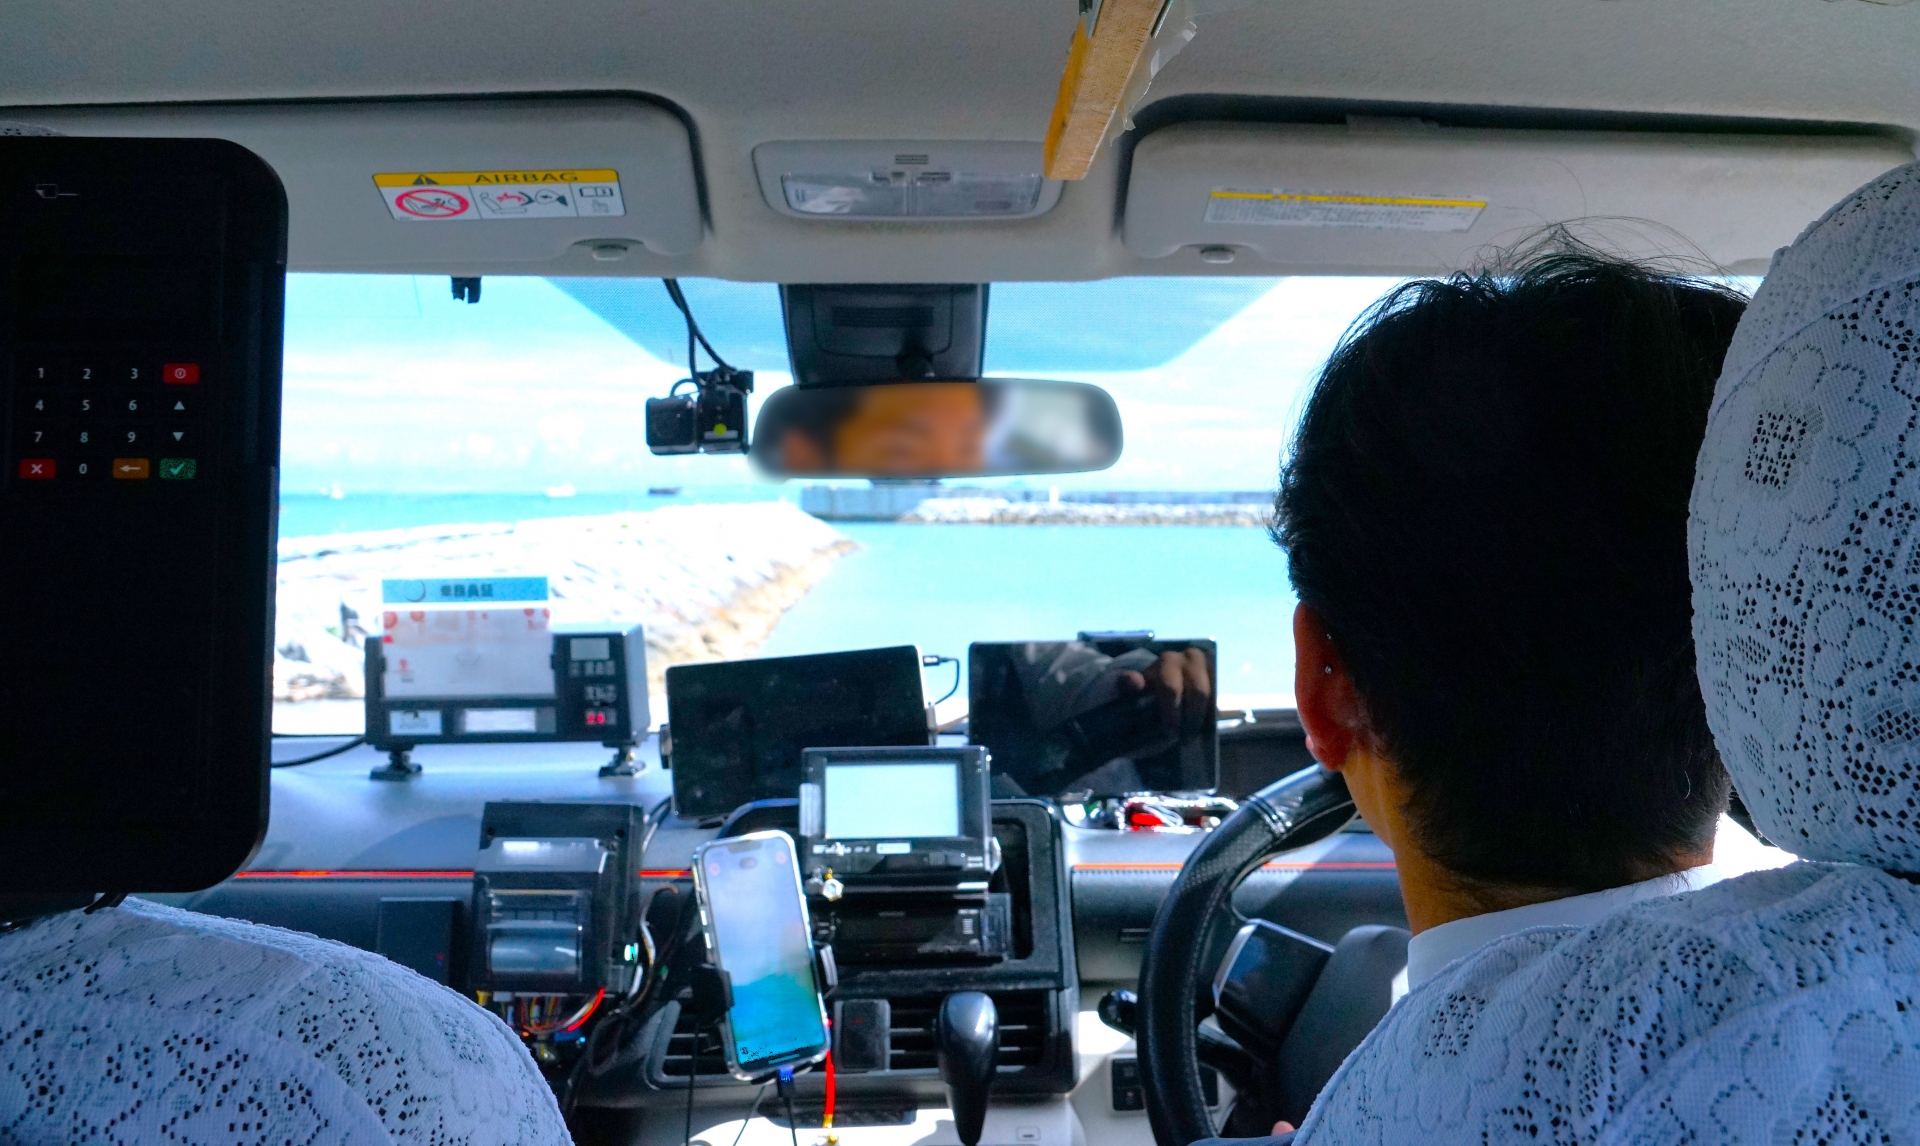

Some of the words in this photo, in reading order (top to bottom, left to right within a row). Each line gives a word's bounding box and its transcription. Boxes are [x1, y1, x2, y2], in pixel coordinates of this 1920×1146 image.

[475, 171, 578, 184] AIRBAG
[37, 367, 44, 379] 1
[82, 368, 91, 380] 2
[130, 367, 139, 379] 3
[35, 399, 44, 411] 4
[82, 399, 90, 411] 5
[128, 399, 137, 411] 6
[34, 431, 43, 443] 7
[79, 431, 89, 443] 8
[127, 431, 137, 443] 9
[78, 463, 88, 475] 0
